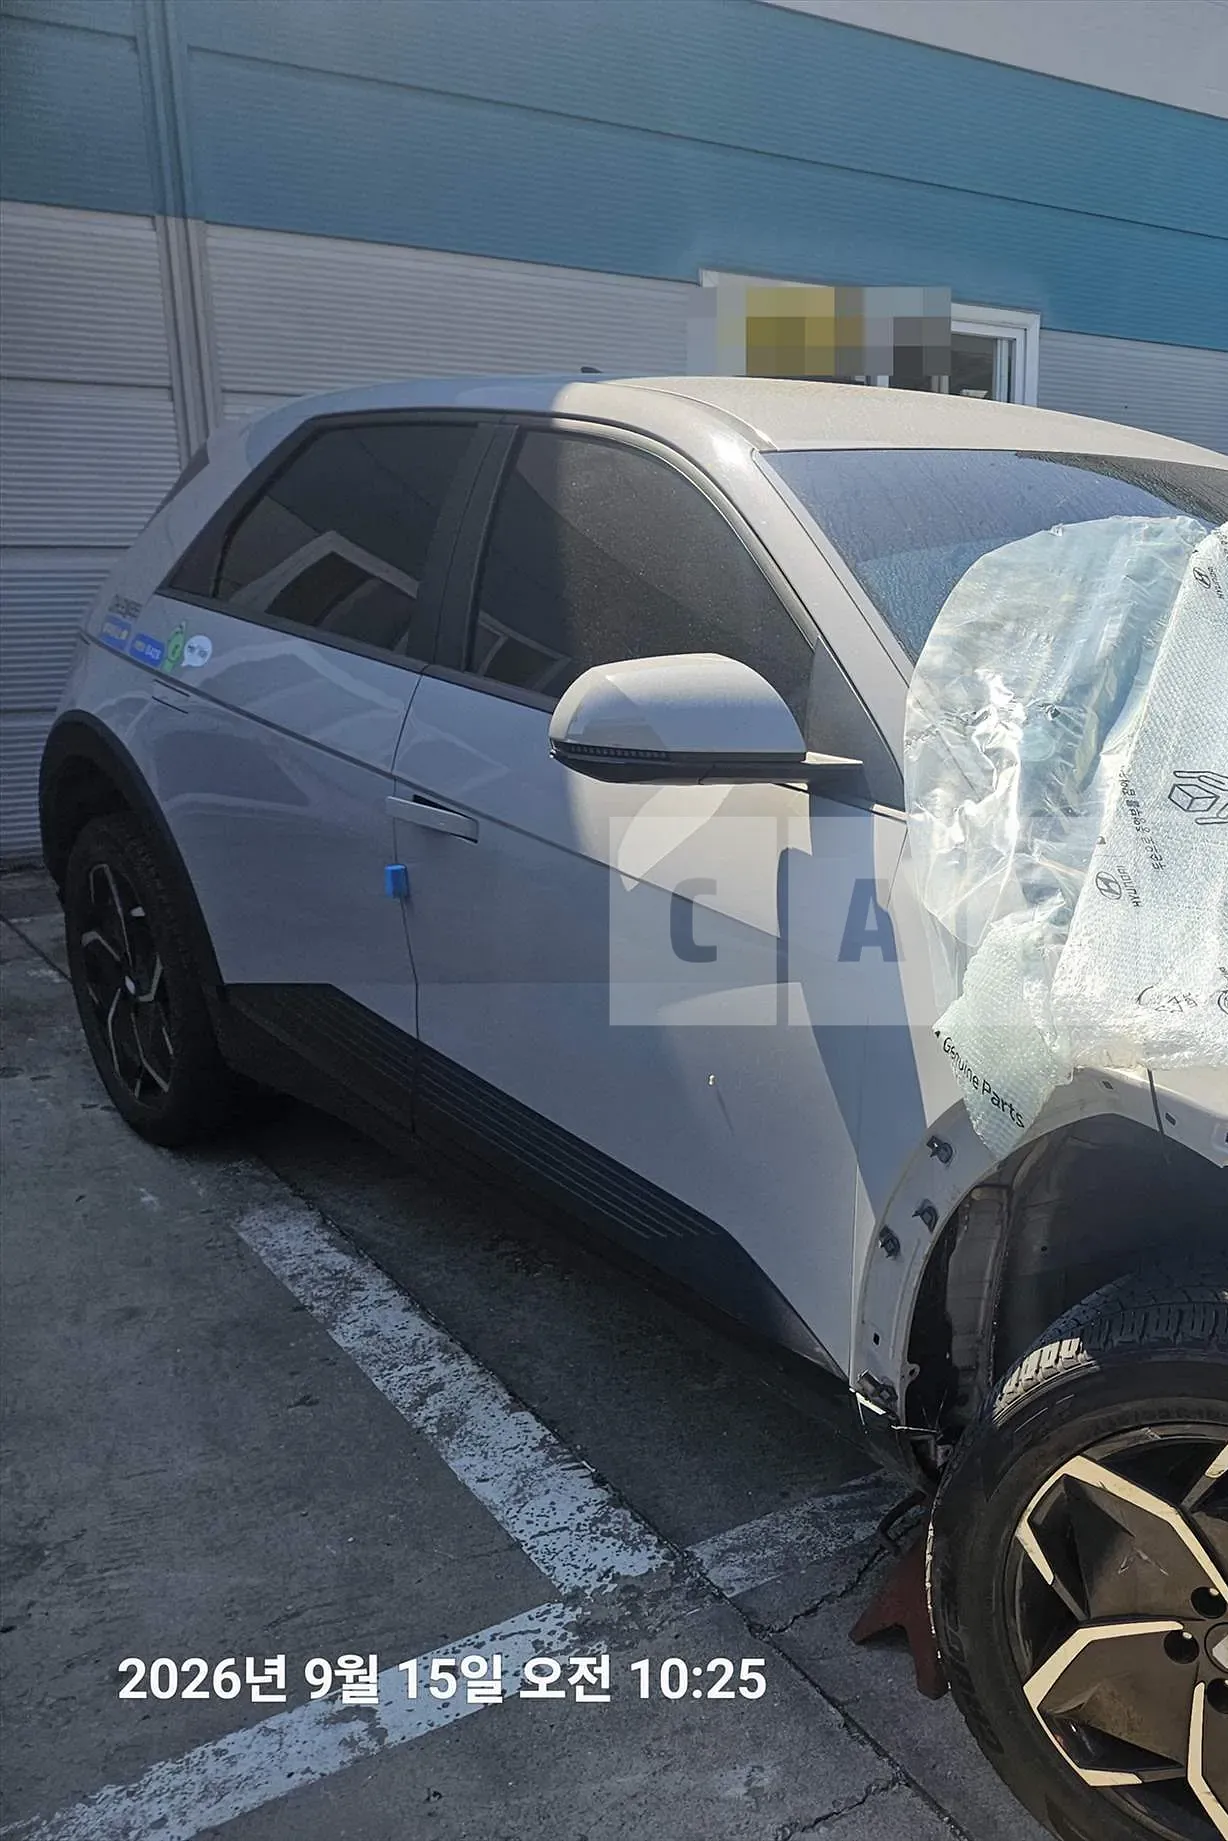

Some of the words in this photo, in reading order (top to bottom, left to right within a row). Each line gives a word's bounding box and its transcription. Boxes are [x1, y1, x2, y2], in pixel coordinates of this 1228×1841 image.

[1116, 865, 1142, 908] HYUNDAI
[943, 1037, 979, 1090] Genuine
[981, 1079, 1025, 1129] Parts
